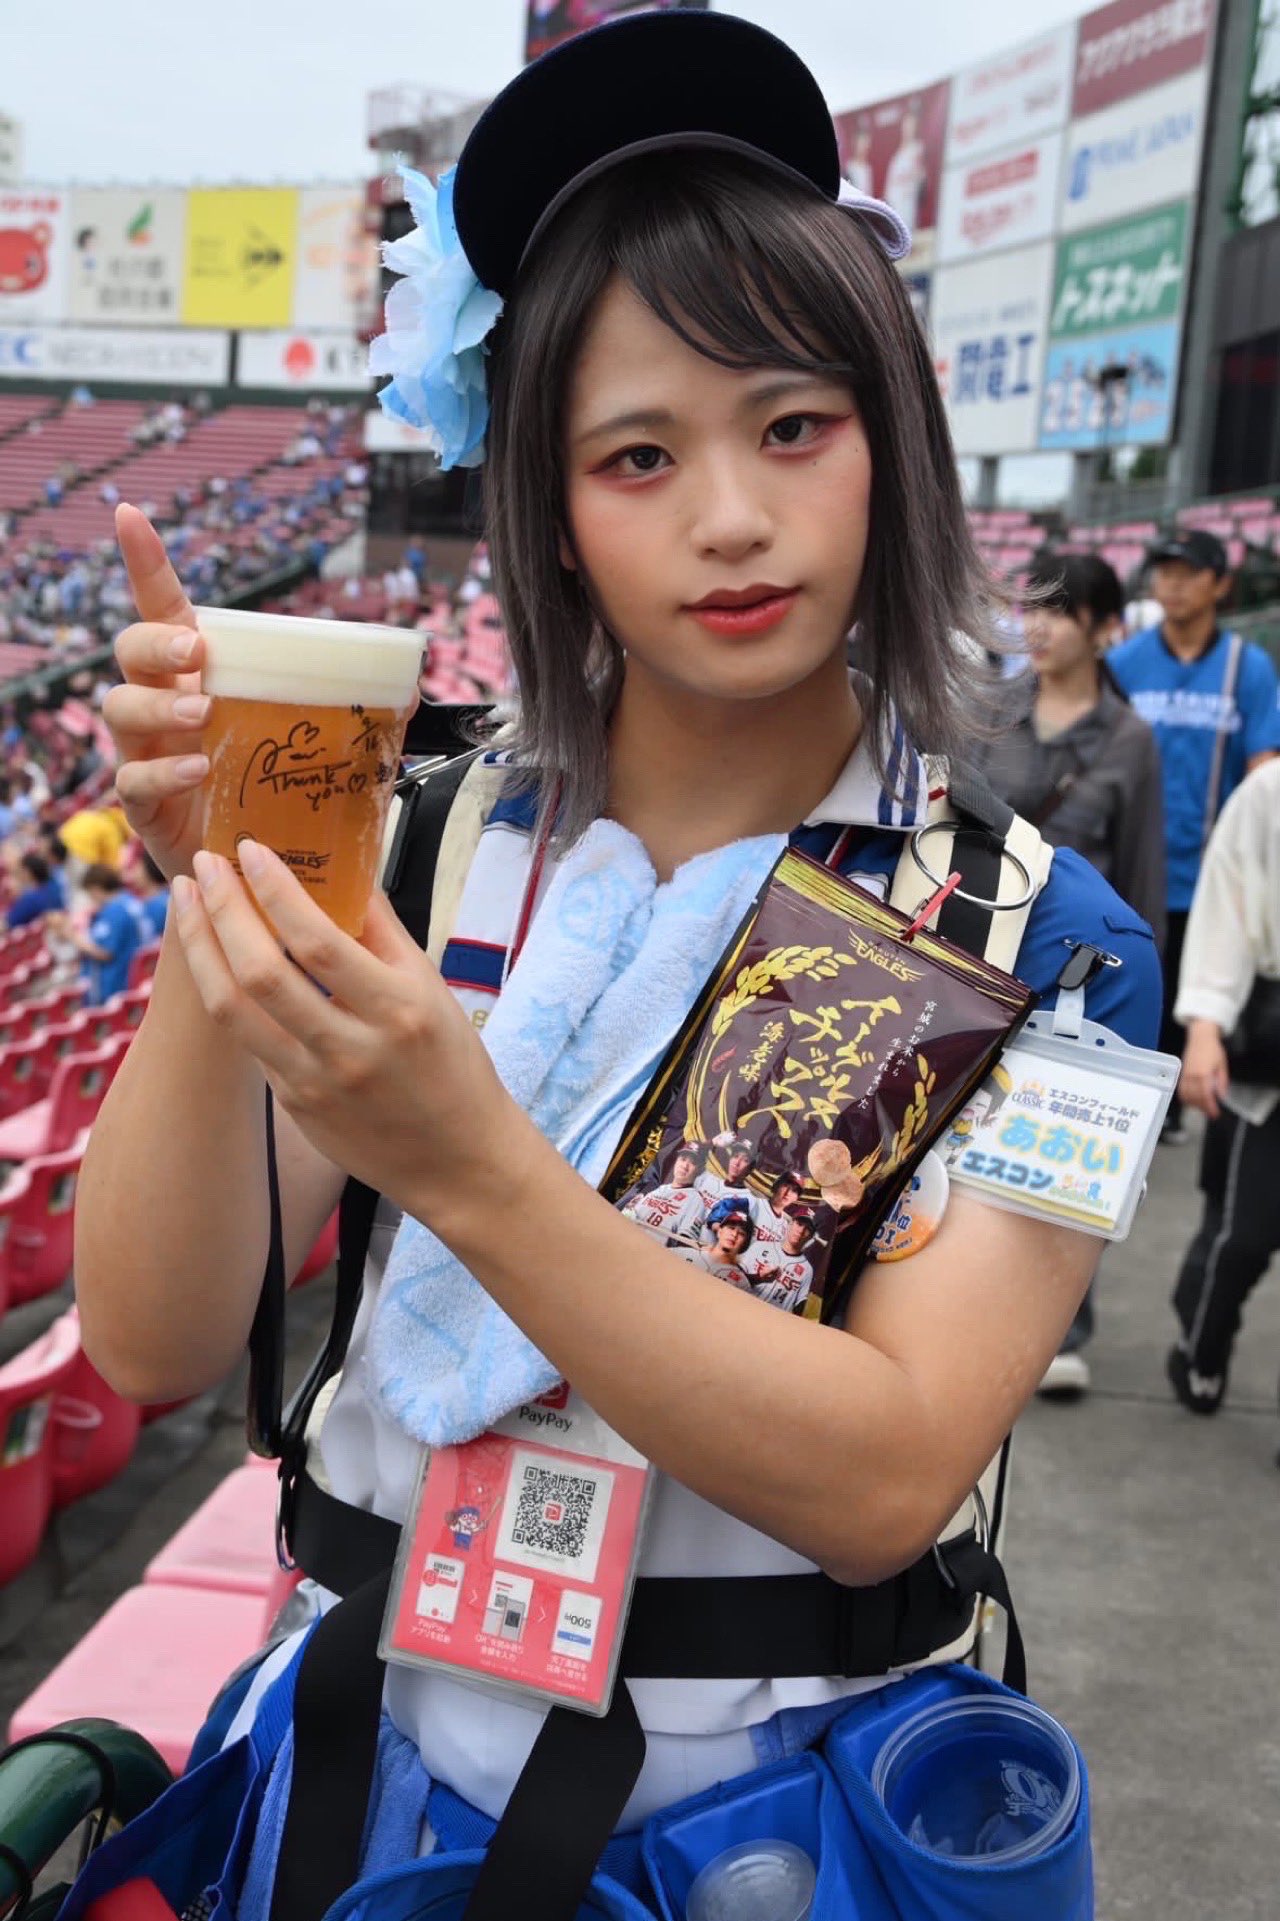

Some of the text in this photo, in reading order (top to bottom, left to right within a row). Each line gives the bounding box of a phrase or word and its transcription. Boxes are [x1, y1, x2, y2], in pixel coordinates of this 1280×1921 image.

[855, 940, 911, 982] EAGLES
[1049, 1101, 1130, 1132] 年間売上1位
[1050, 1088, 1140, 1118] エスコンフィールド
[1001, 1115, 1121, 1172] あおい
[963, 1151, 1053, 1189] エスコン
[646, 1212, 663, 1227] 18
[519, 1405, 572, 1432] PayPay
